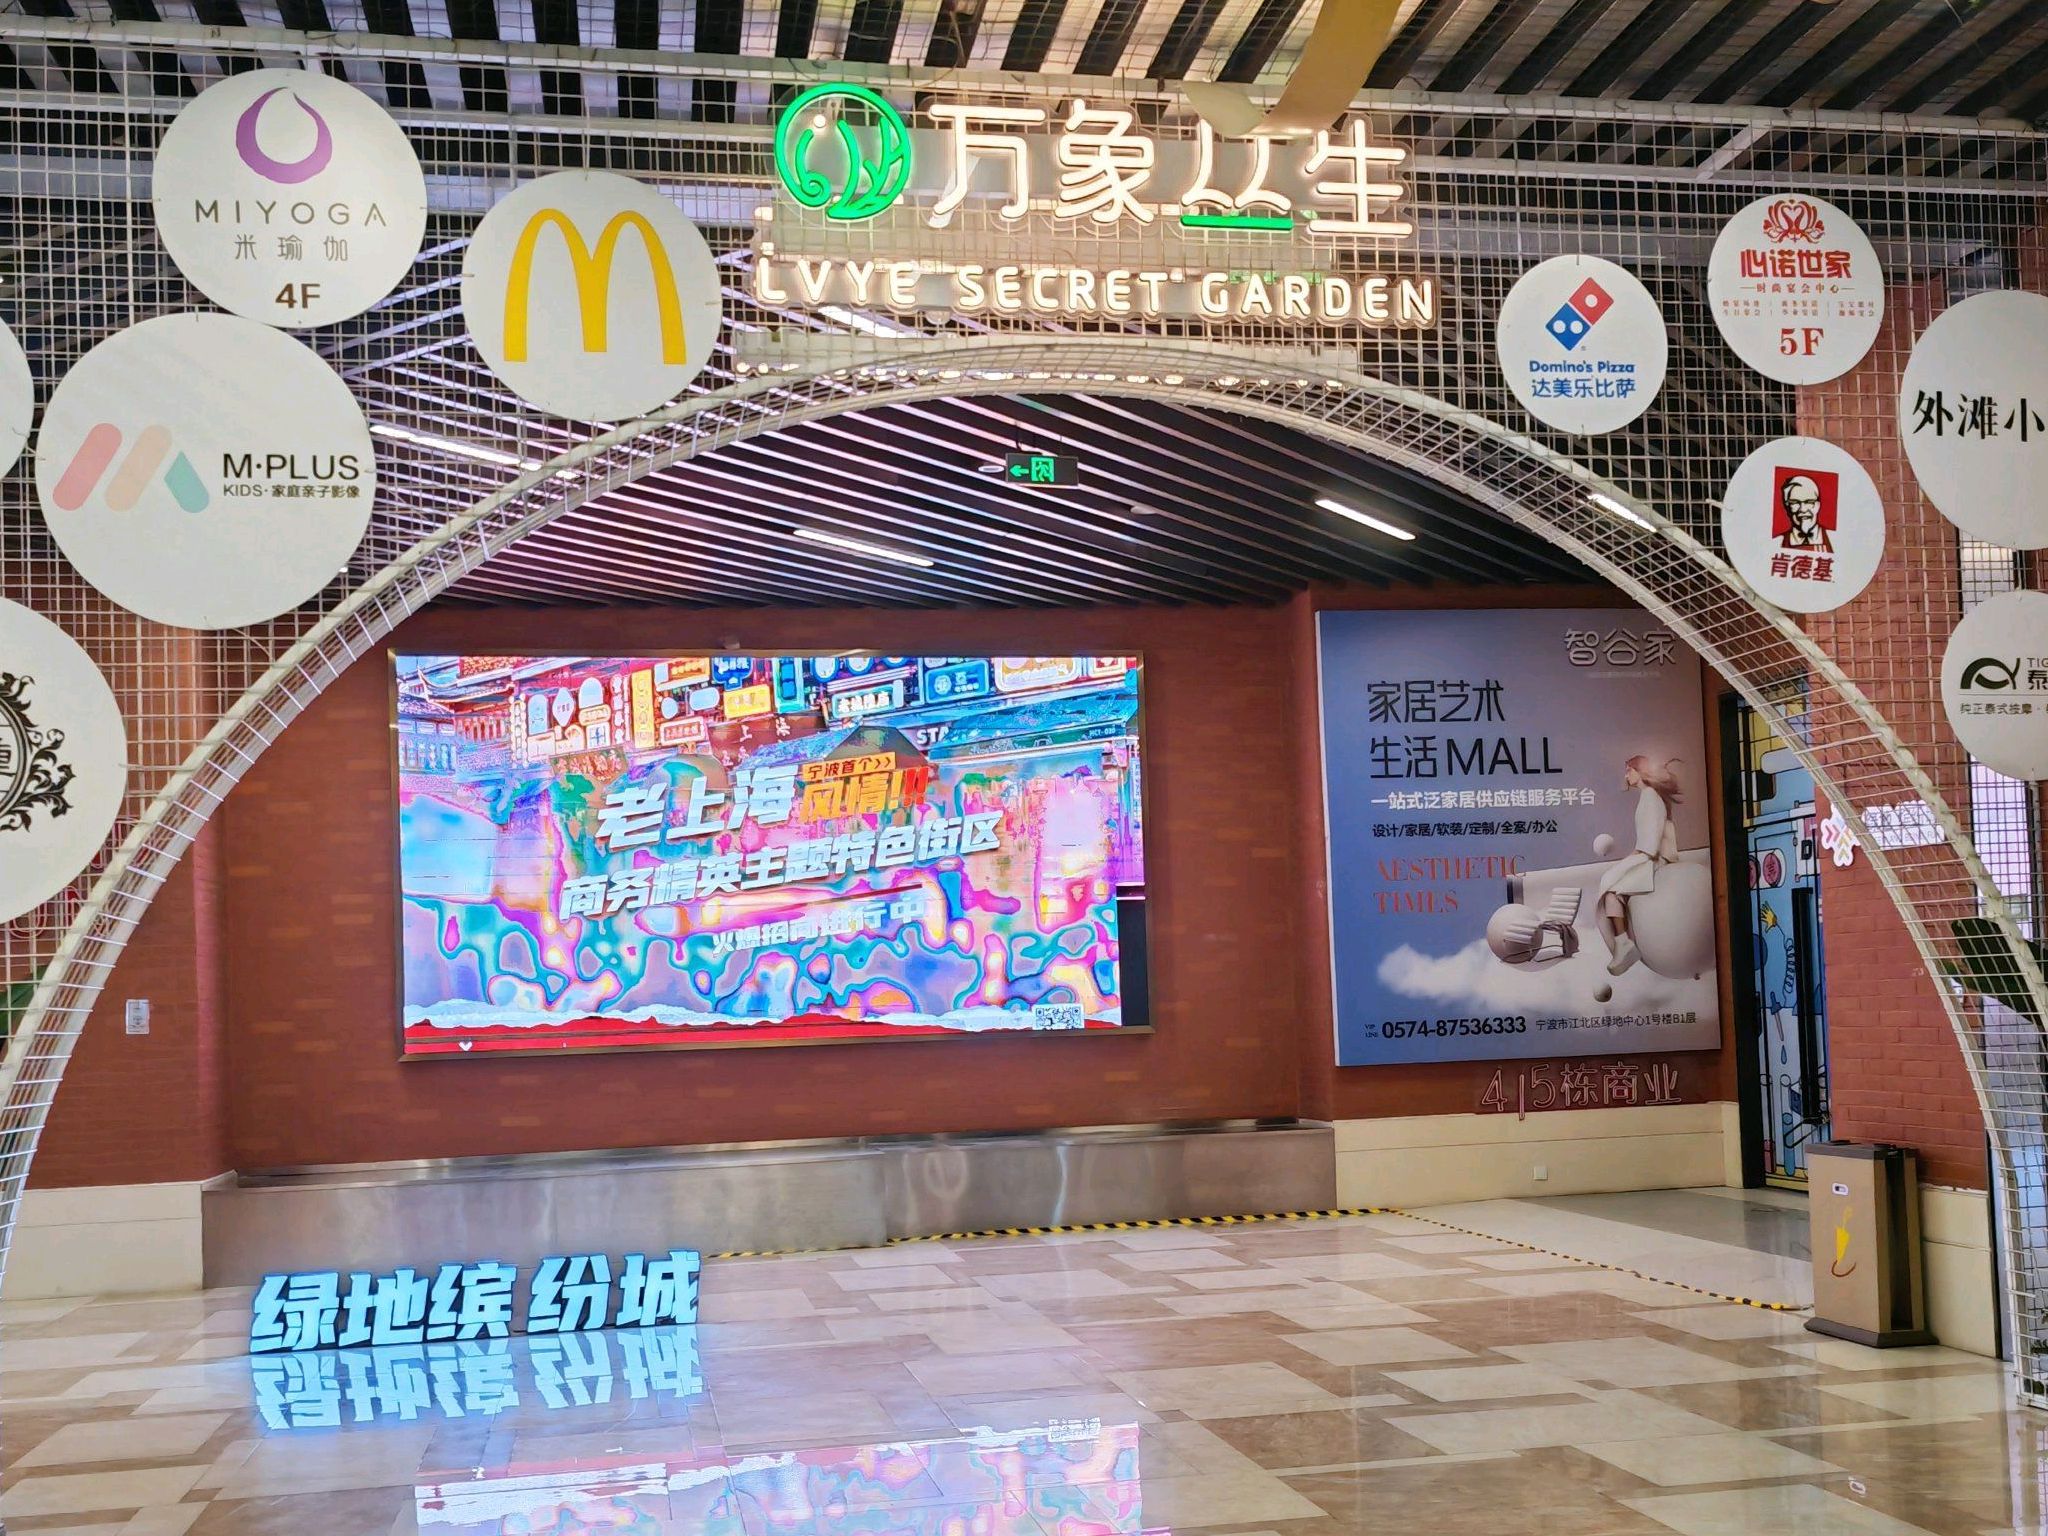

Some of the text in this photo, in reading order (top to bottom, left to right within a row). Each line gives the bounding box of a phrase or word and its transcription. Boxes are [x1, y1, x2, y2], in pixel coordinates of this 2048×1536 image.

[195, 199, 387, 227] MIYOGA
[234, 233, 348, 262] 米瑜伽
[1740, 248, 1853, 279] 心诺世家
[275, 283, 321, 309] 4F
[758, 257, 1433, 321] LVYE SECRET GARDEN
[1779, 327, 1825, 356] 5F
[1529, 360, 1636, 373] Domino's Pizza
[1531, 377, 1637, 399] 达美乐比萨
[1912, 389, 2046, 443] 外滩小
[1771, 552, 1834, 583] 肯德基
[1563, 627, 1677, 667] 智谷家
[1367, 679, 1506, 724] 家居艺术
[1370, 787, 1597, 810] 一站式泛家居供应链服务平台
[559, 810, 1003, 921] 商务精英主题特色街区
[1377, 854, 1527, 882] AESTHETIC
[1372, 889, 1459, 915] TIMES
[1381, 1015, 1527, 1039] 0574-87536333
[250, 1249, 701, 1354] 绿地缤纷城
